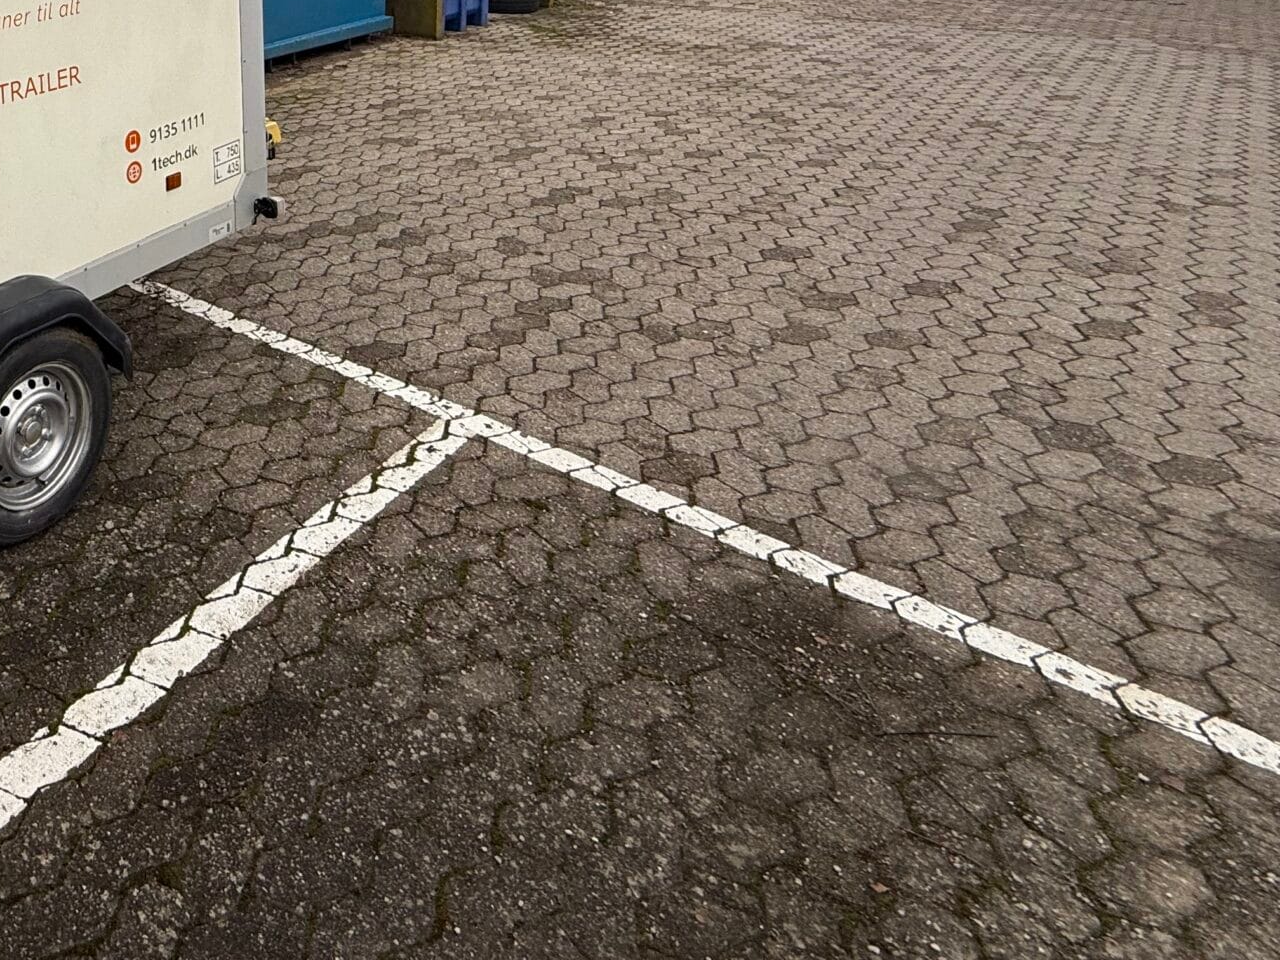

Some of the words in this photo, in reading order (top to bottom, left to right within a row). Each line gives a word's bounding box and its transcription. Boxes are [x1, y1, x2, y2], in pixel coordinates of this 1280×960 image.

[37, 2, 53, 23] til
[149, 121, 178, 144] 9135
[180, 112, 205, 132] 1111
[151, 144, 198, 171] 1tech.dk
[226, 144, 239, 158] 750
[227, 160, 239, 174] 435
